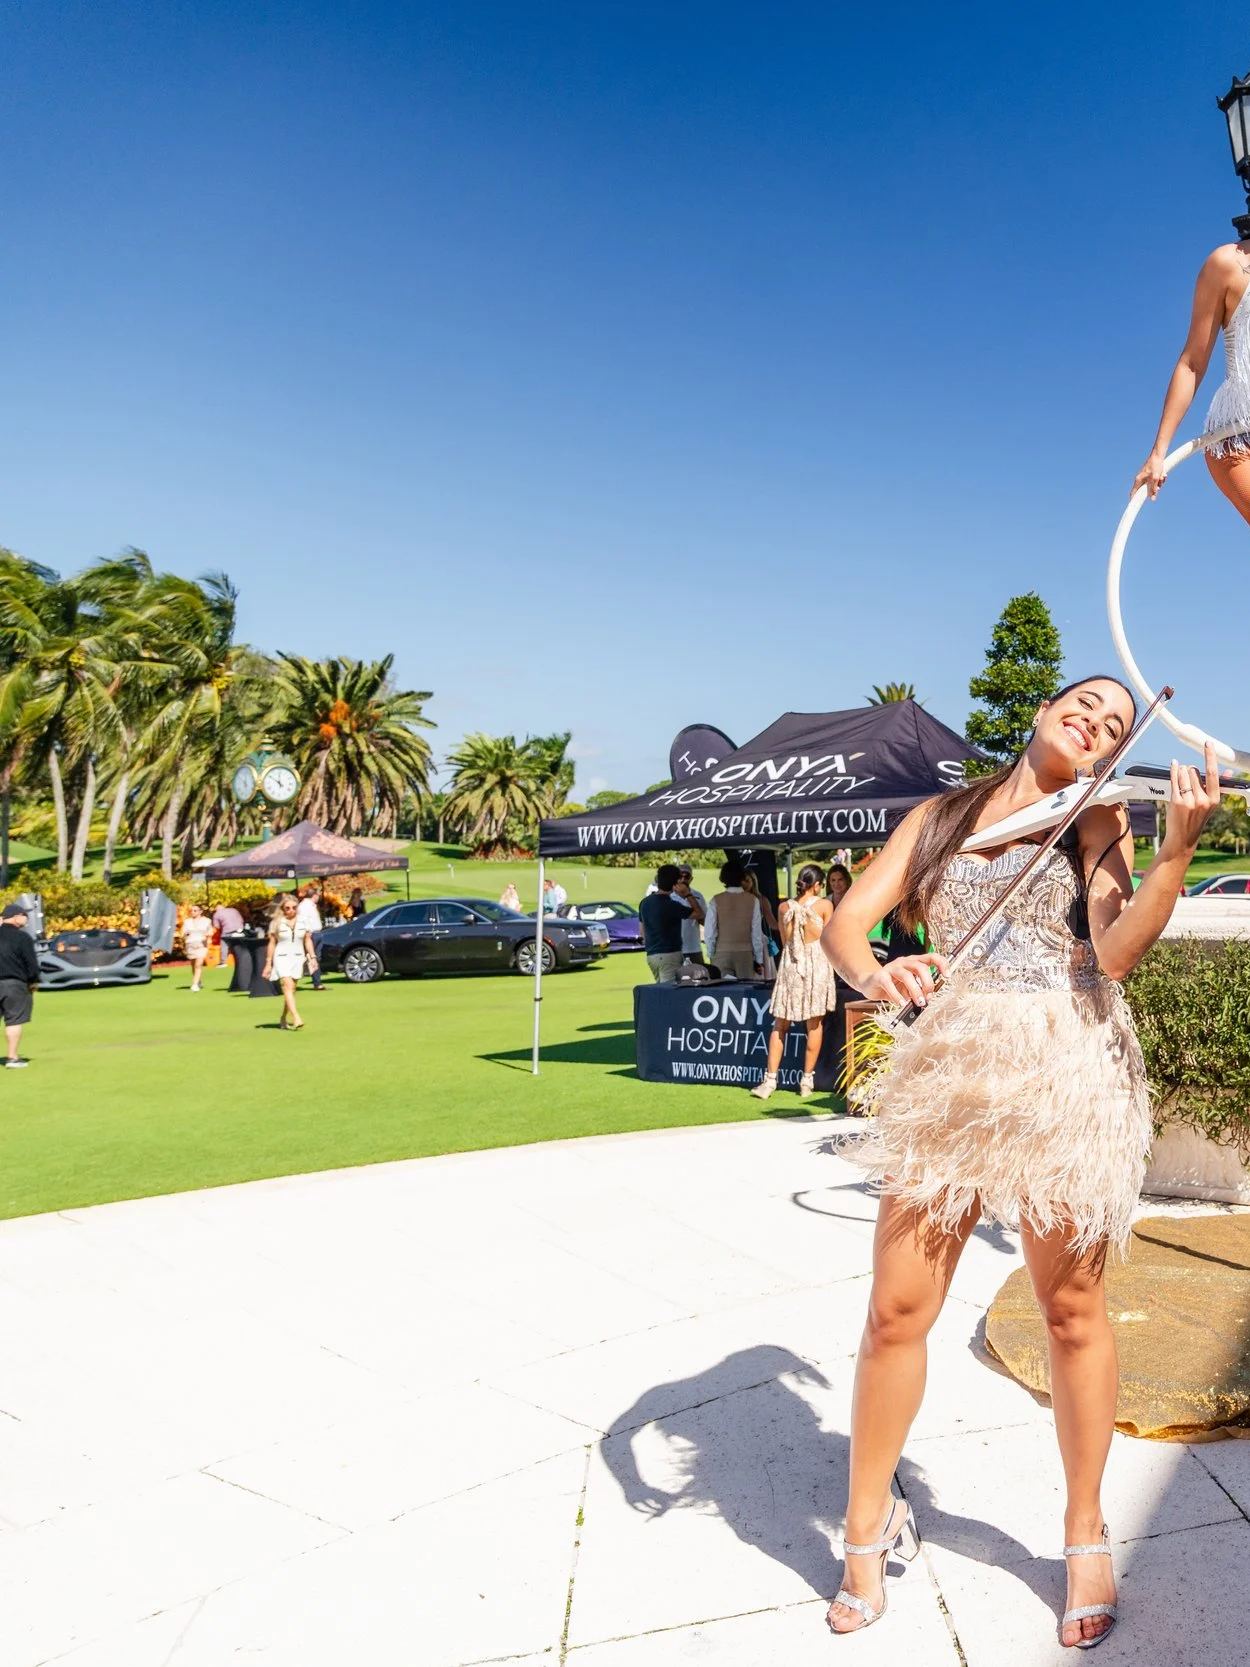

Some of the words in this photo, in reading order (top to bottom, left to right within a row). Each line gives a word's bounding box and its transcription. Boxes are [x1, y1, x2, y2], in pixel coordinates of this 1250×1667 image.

[711, 752, 866, 783] ONYX
[649, 776, 876, 806] HOSPITALITY
[577, 808, 887, 847] WWW.ONYXHOSPITALITY.COM
[667, 1027, 809, 1057] HOSPITAIT
